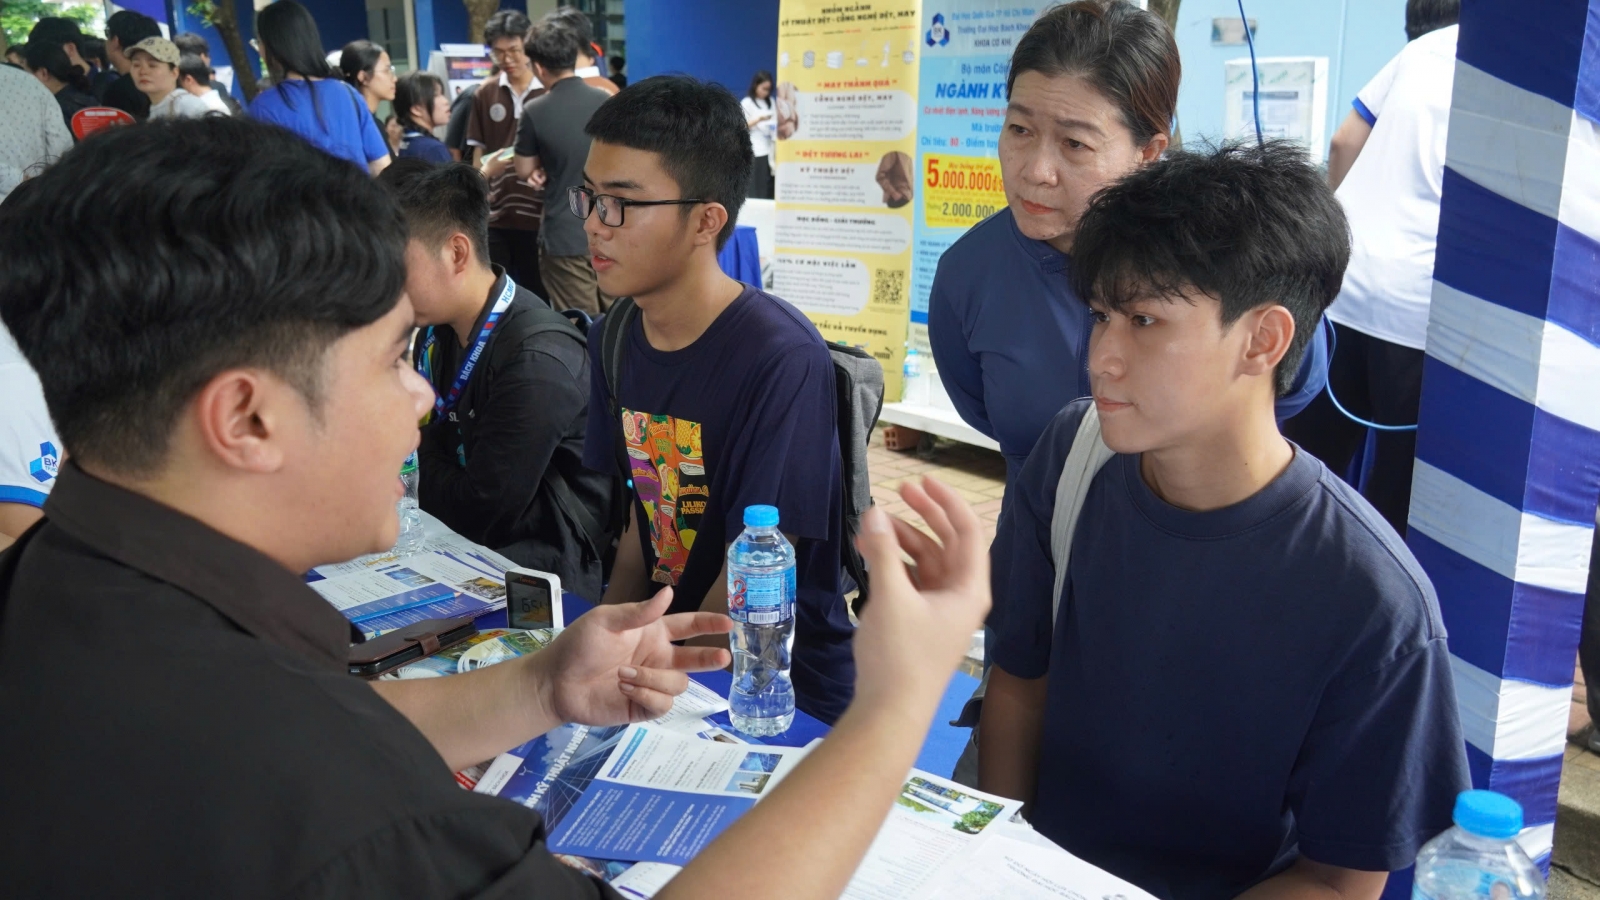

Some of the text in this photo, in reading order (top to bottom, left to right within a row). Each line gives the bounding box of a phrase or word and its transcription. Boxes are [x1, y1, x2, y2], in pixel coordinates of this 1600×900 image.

[935, 79, 989, 99] NGÀNH
[472, 340, 487, 363] KHOA
[44, 458, 58, 468] BK
[544, 752, 571, 781] THUẬT
